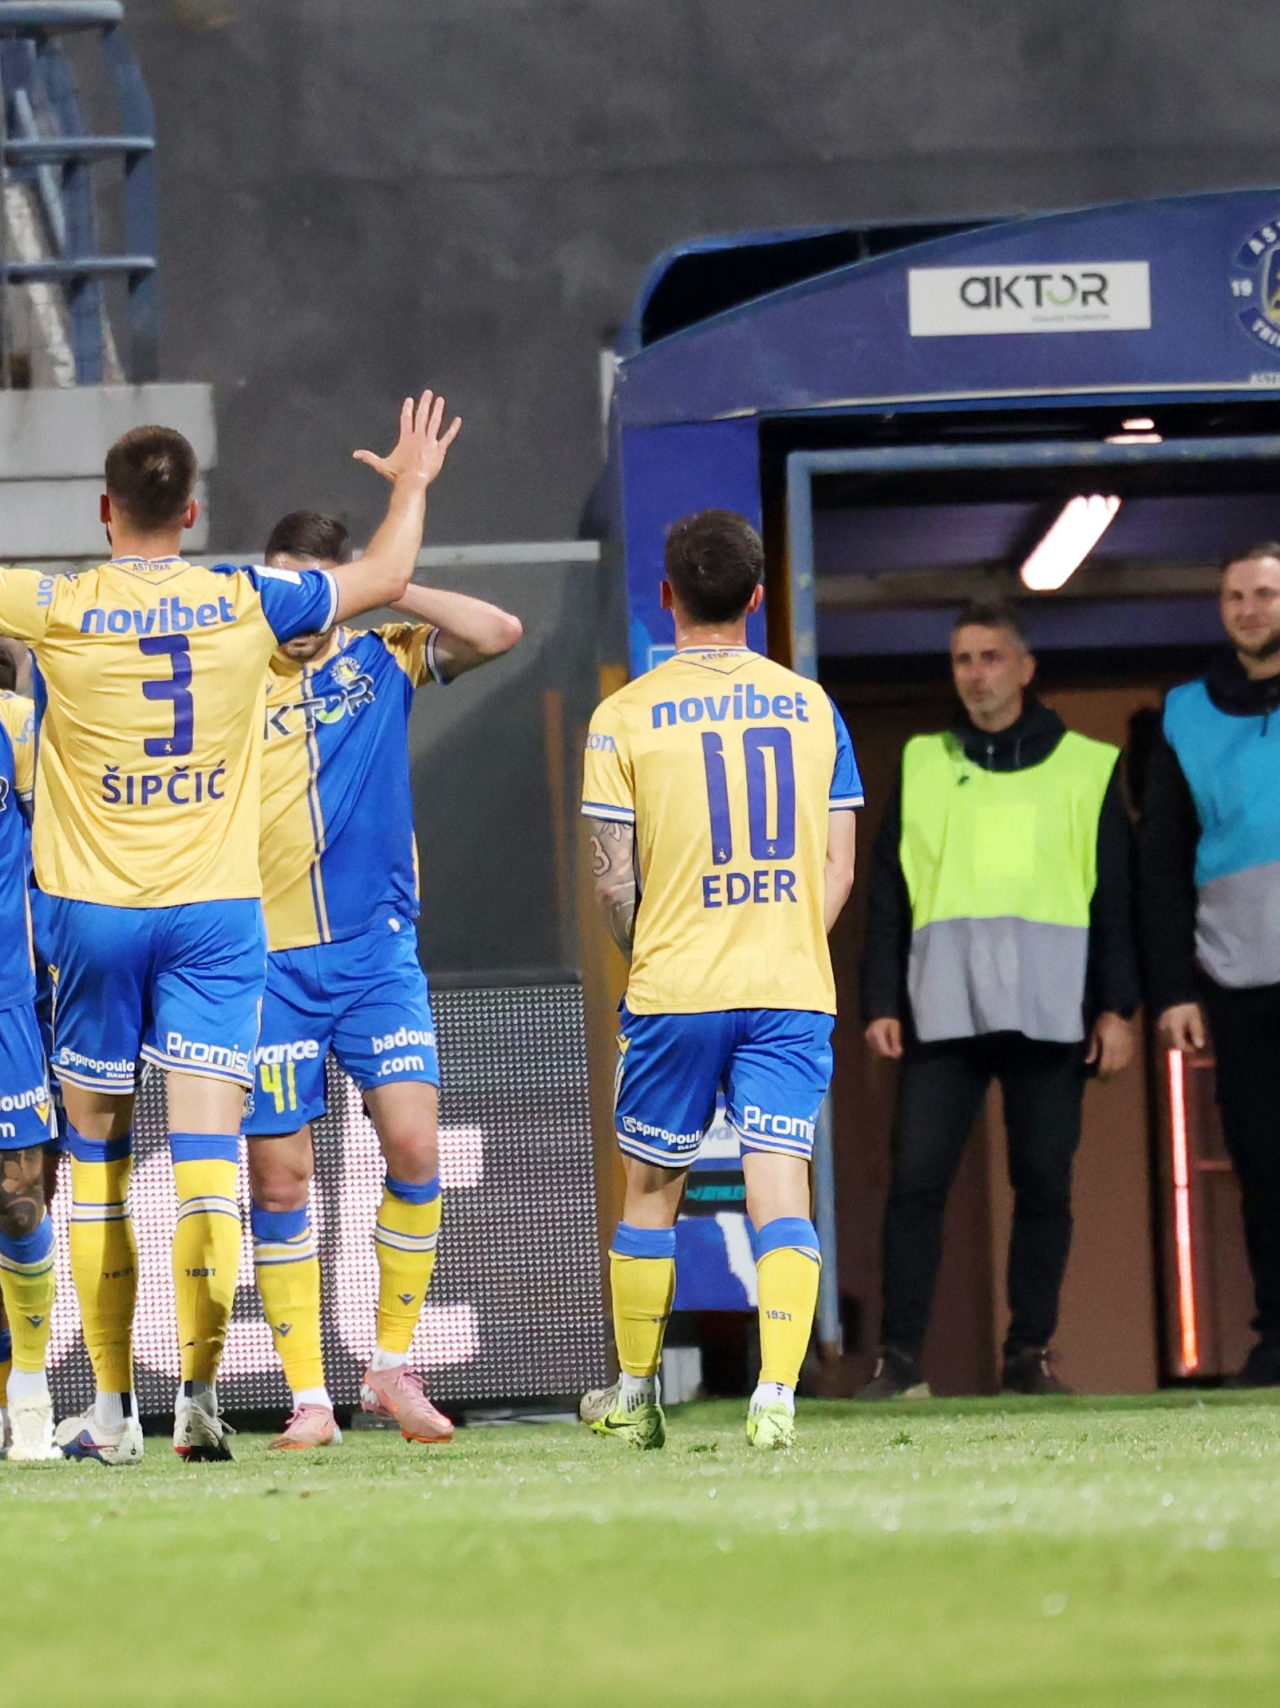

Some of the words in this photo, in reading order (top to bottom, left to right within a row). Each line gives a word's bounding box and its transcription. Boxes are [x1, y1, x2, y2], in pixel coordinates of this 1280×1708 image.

[80, 596, 238, 635] novibet
[138, 633, 194, 757] 3
[263, 673, 376, 741] KTOR
[651, 683, 809, 729] novibet
[102, 759, 226, 805] ŠIPČIĆ
[701, 727, 796, 866] 10
[702, 869, 798, 908] EDER
[254, 1039, 320, 1064] vance
[376, 1055, 425, 1078] .com
[260, 1061, 297, 1114] 41
